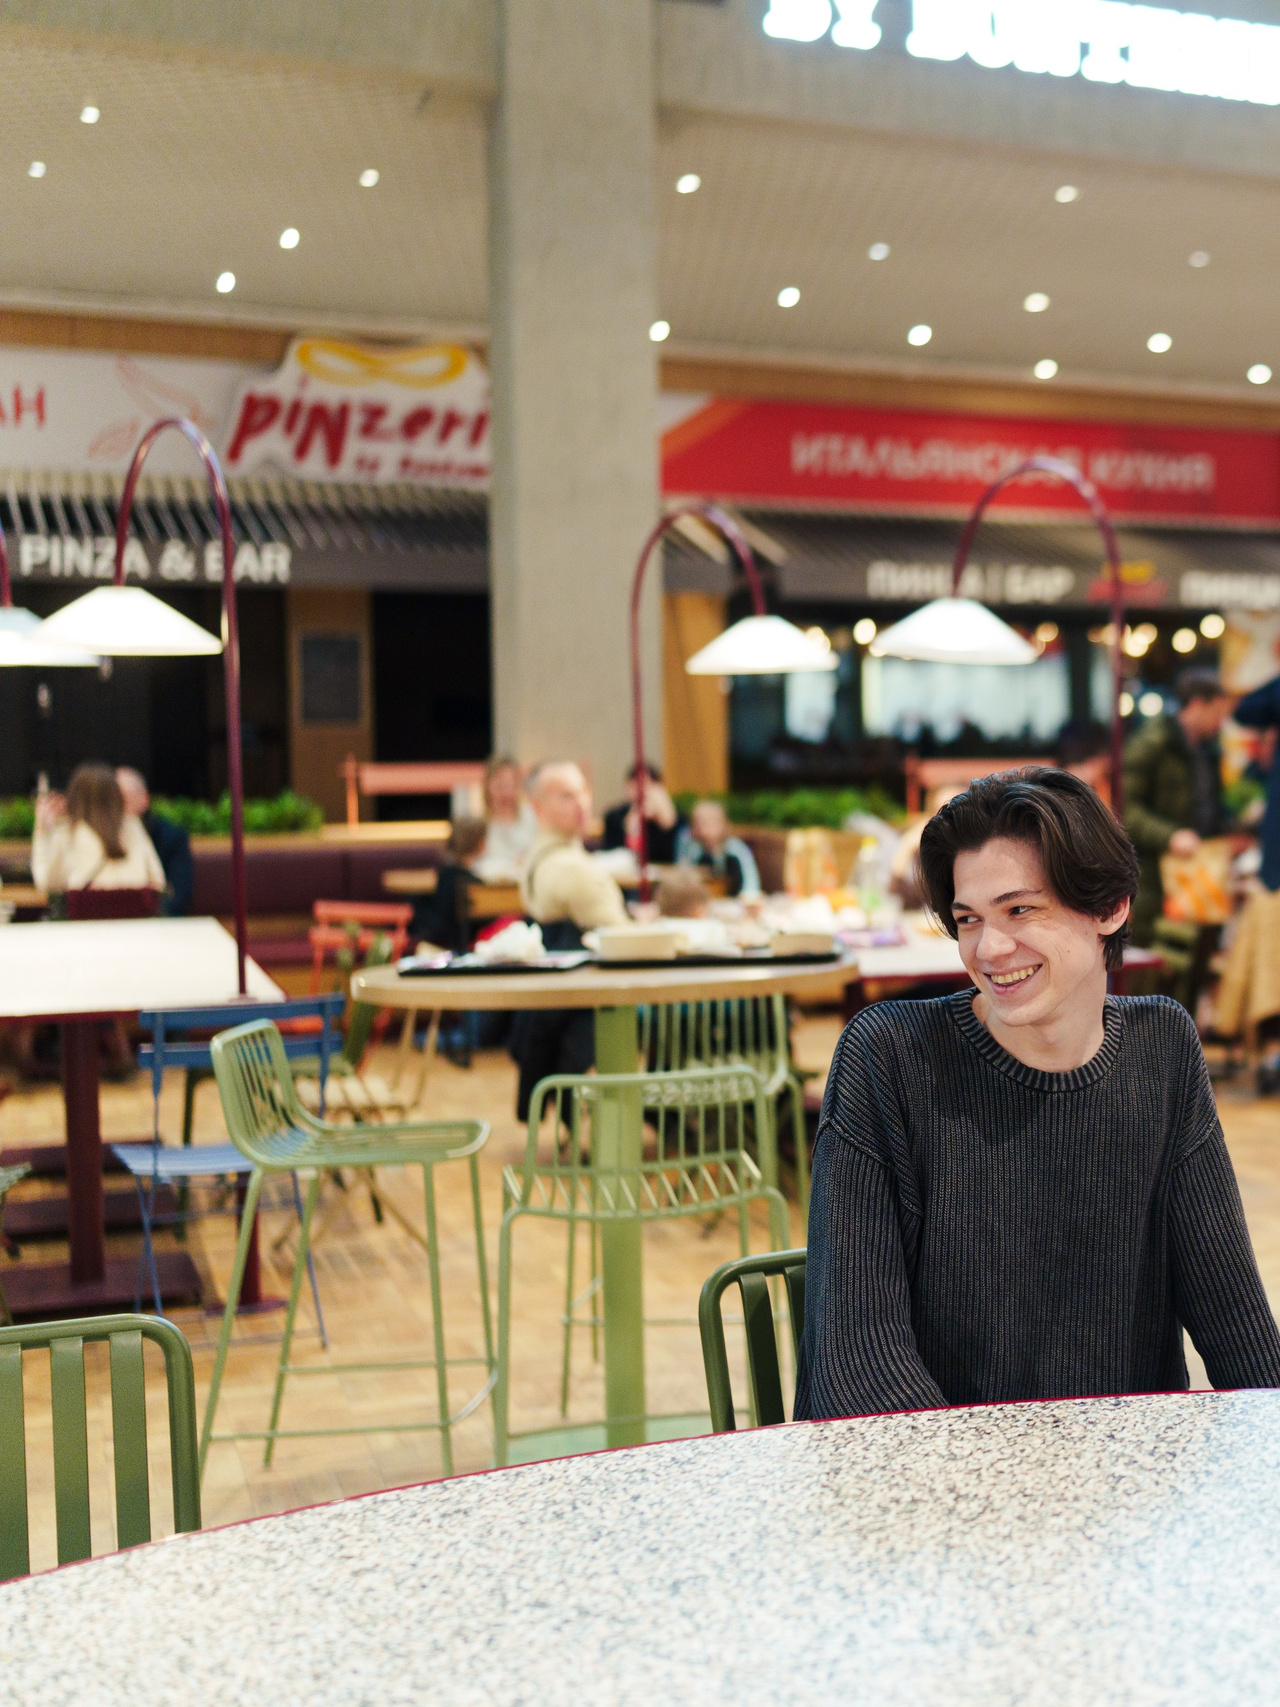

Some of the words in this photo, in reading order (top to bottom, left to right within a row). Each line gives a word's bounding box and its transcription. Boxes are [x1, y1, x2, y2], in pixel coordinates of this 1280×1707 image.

[791, 431, 1083, 486] ИТАЛЬЯНСКАЯ
[1089, 447, 1215, 492] КУХНЯ
[19, 533, 149, 579] PINZA
[159, 538, 196, 581] &
